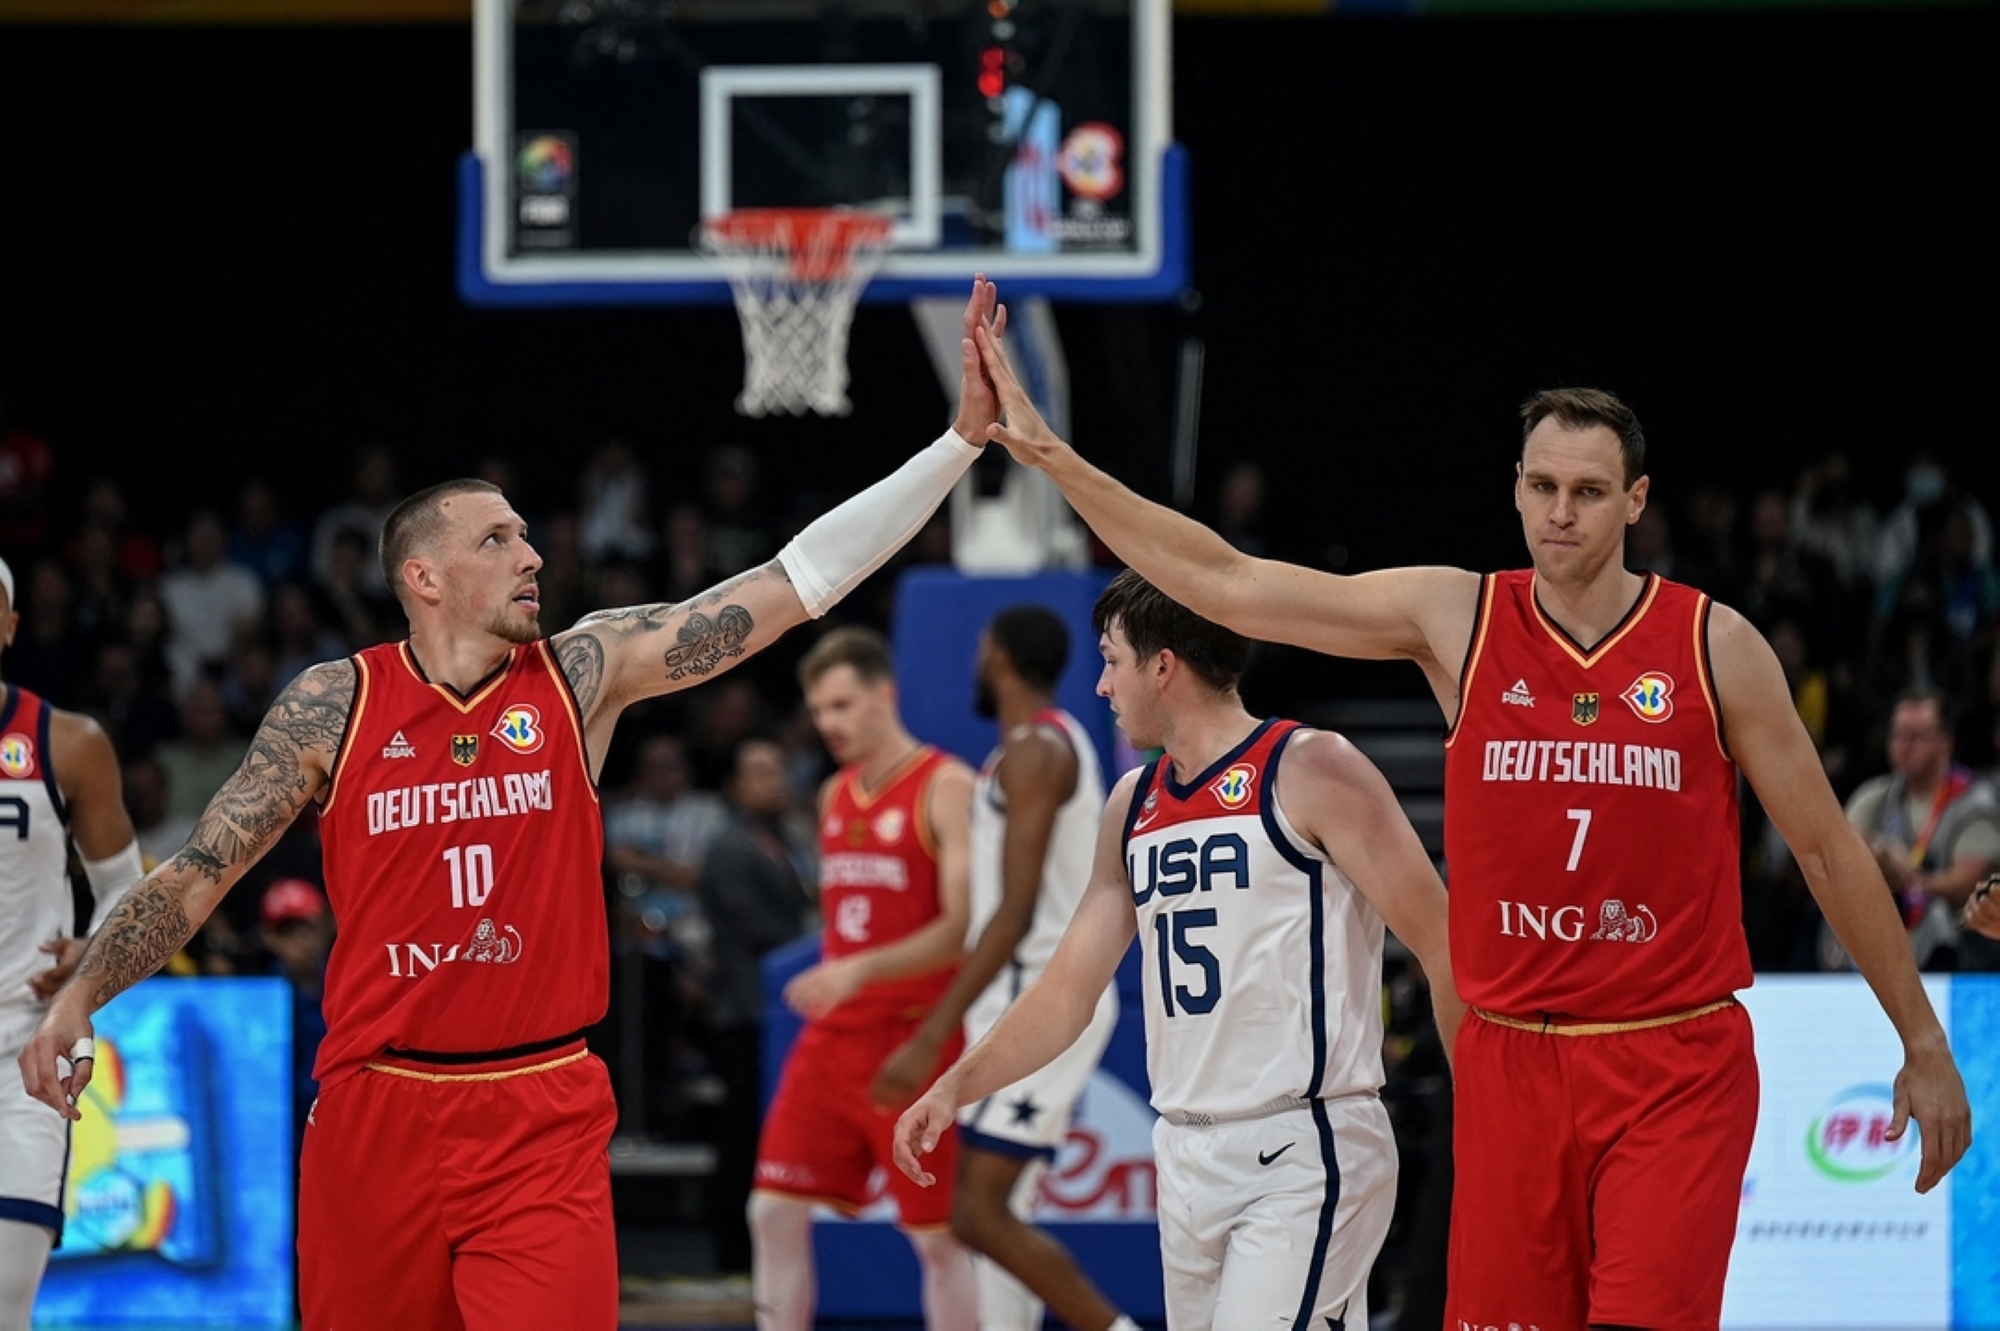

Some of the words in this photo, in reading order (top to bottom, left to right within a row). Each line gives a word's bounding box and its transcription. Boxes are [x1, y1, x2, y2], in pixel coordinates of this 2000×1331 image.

[1483, 740, 1682, 792] DEUTSCHLAND
[1129, 832, 1250, 908] USA
[1565, 808, 1592, 872] 7
[442, 844, 494, 909] 10
[1498, 900, 1585, 942] ING
[385, 943, 460, 978] IN
[1154, 907, 1222, 1018] 15
